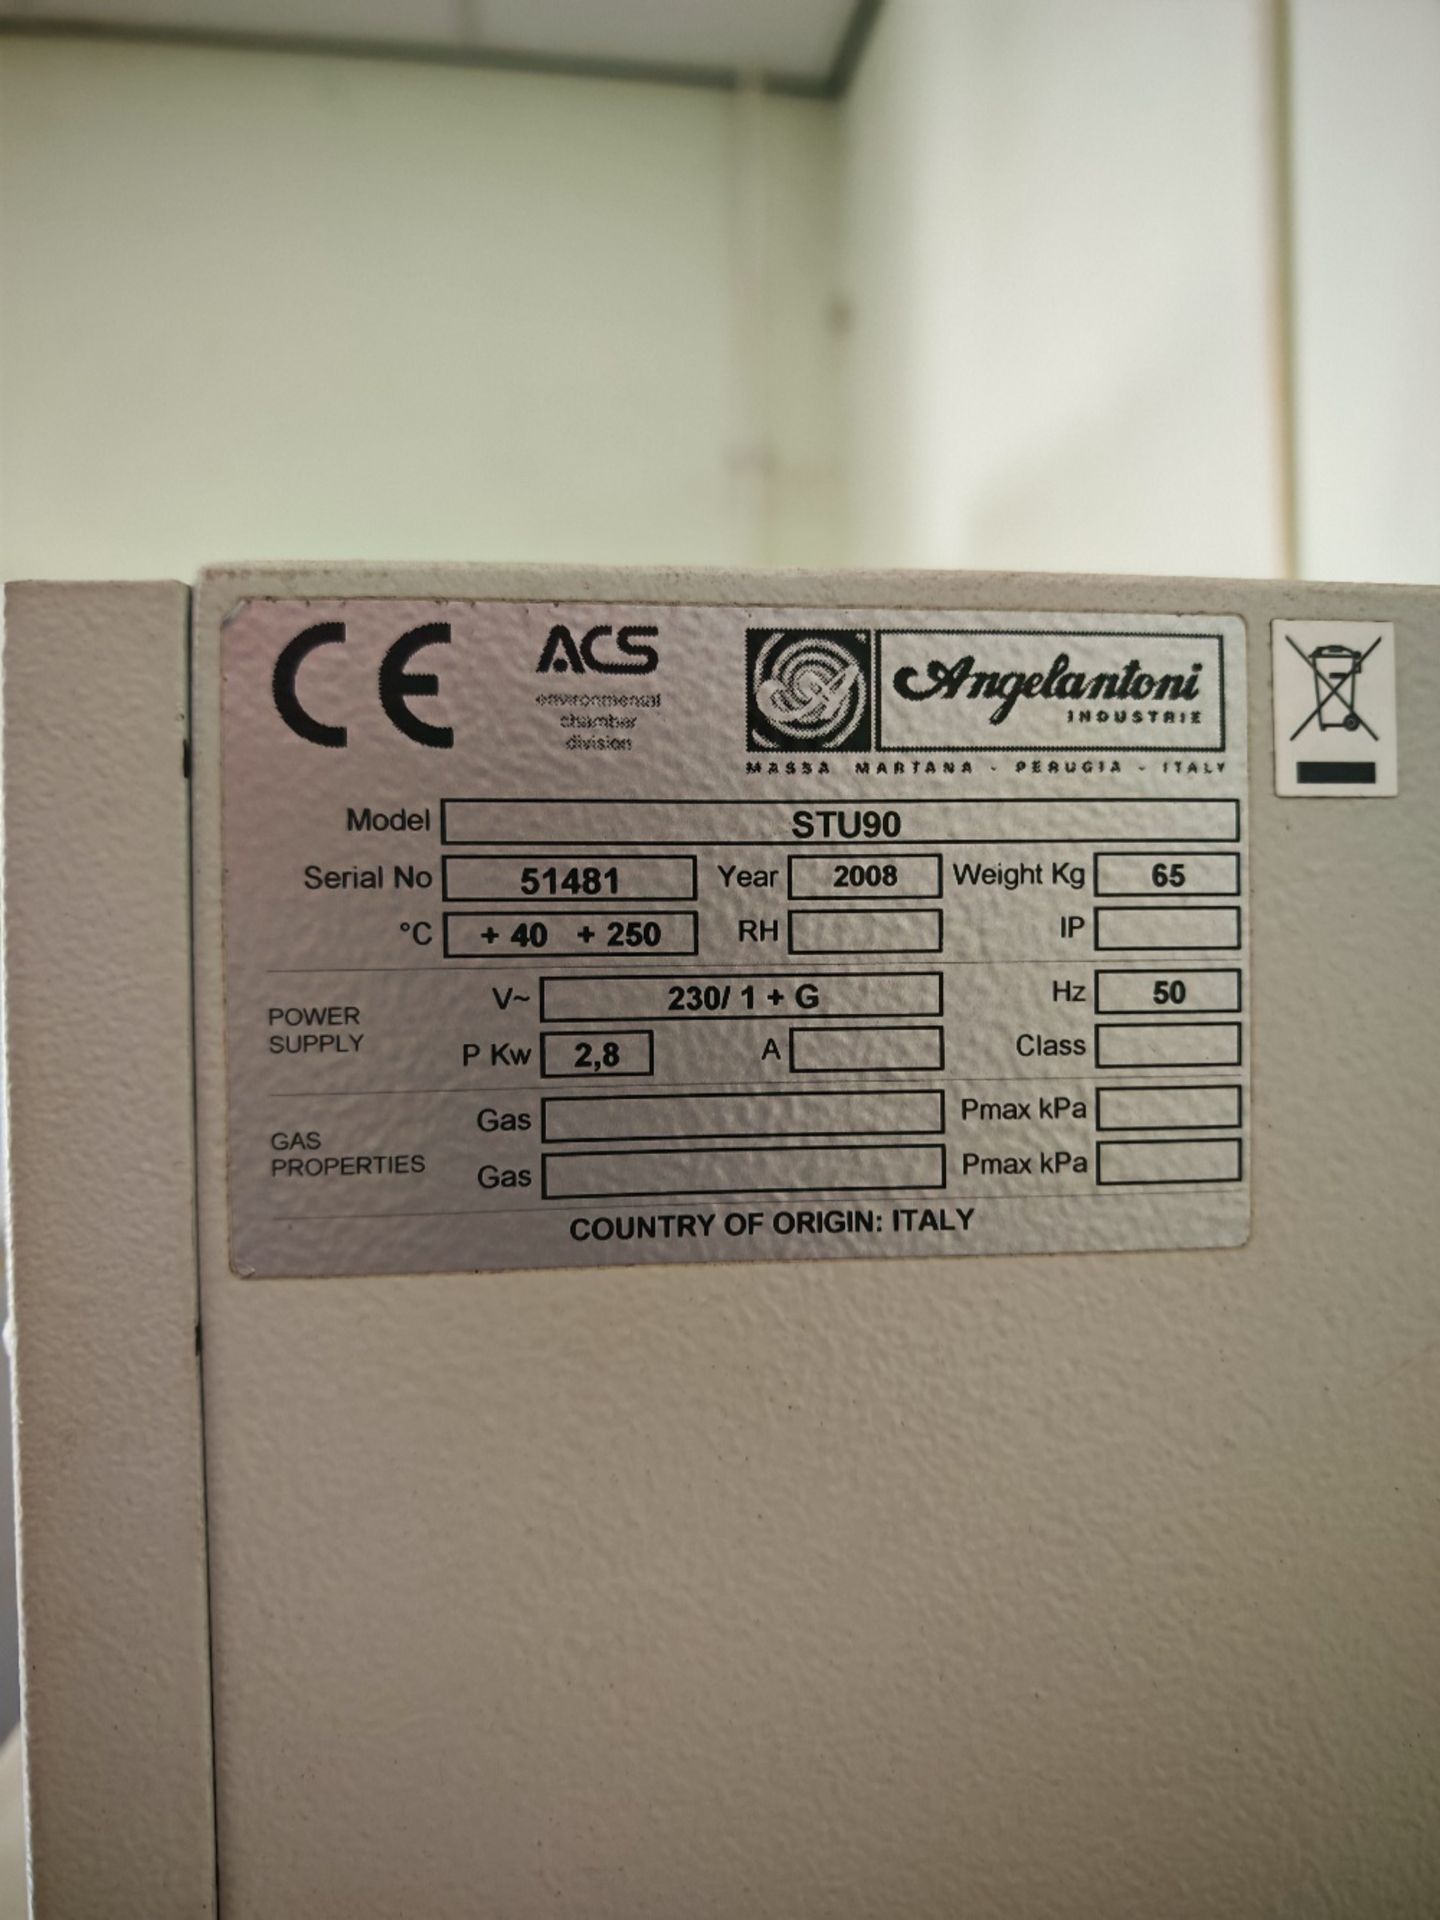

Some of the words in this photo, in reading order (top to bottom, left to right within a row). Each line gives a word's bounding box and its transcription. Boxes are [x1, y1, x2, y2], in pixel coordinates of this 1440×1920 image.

[536, 625, 659, 674] ACS
[893, 653, 1203, 724] Angelantoni
[1067, 710, 1202, 723] INDUSTRIE
[564, 735, 632, 750] division
[746, 764, 831, 774] MASSA
[856, 763, 973, 774] MARTANA
[1016, 761, 1122, 773] PERUGIA
[1163, 762, 1226, 774] ITALY
[347, 807, 430, 831] Model
[792, 810, 901, 839] STU90
[304, 865, 383, 889] Serial
[394, 866, 432, 889] No
[520, 867, 619, 895] 51481
[718, 866, 778, 887] Year
[834, 865, 898, 887] 2008
[953, 863, 1043, 889] Weight
[1052, 864, 1085, 890] Kg
[1151, 864, 1186, 887] 65
[510, 923, 547, 947] 40
[607, 922, 661, 947] 250
[739, 921, 778, 942] RH
[1060, 917, 1085, 938] IP
[668, 986, 731, 1011] 230/
[741, 986, 754, 1009] 1
[795, 986, 819, 1008] G
[1053, 982, 1086, 1002] Hz
[1153, 981, 1186, 1004] 50
[268, 1006, 360, 1026] POWER
[269, 1034, 364, 1053] SUPPLY
[761, 1040, 781, 1060] A
[1016, 1035, 1086, 1057] Class
[462, 1045, 480, 1066] P
[491, 1044, 532, 1065] Kw
[574, 1042, 620, 1071] 2,8
[477, 1110, 532, 1131] Gas
[961, 1100, 1031, 1120] Pmax
[1039, 1099, 1087, 1119] kPa
[271, 1132, 321, 1151] GAS
[272, 1155, 426, 1177] PROPERTIES
[962, 1154, 1032, 1174] Pmax
[1040, 1153, 1088, 1173] kPa
[478, 1166, 532, 1188] Gas
[569, 1214, 715, 1242] COUNTRY
[724, 1212, 764, 1236] OF
[773, 1211, 882, 1234] ORIGIN:
[892, 1208, 975, 1231] ITALY
